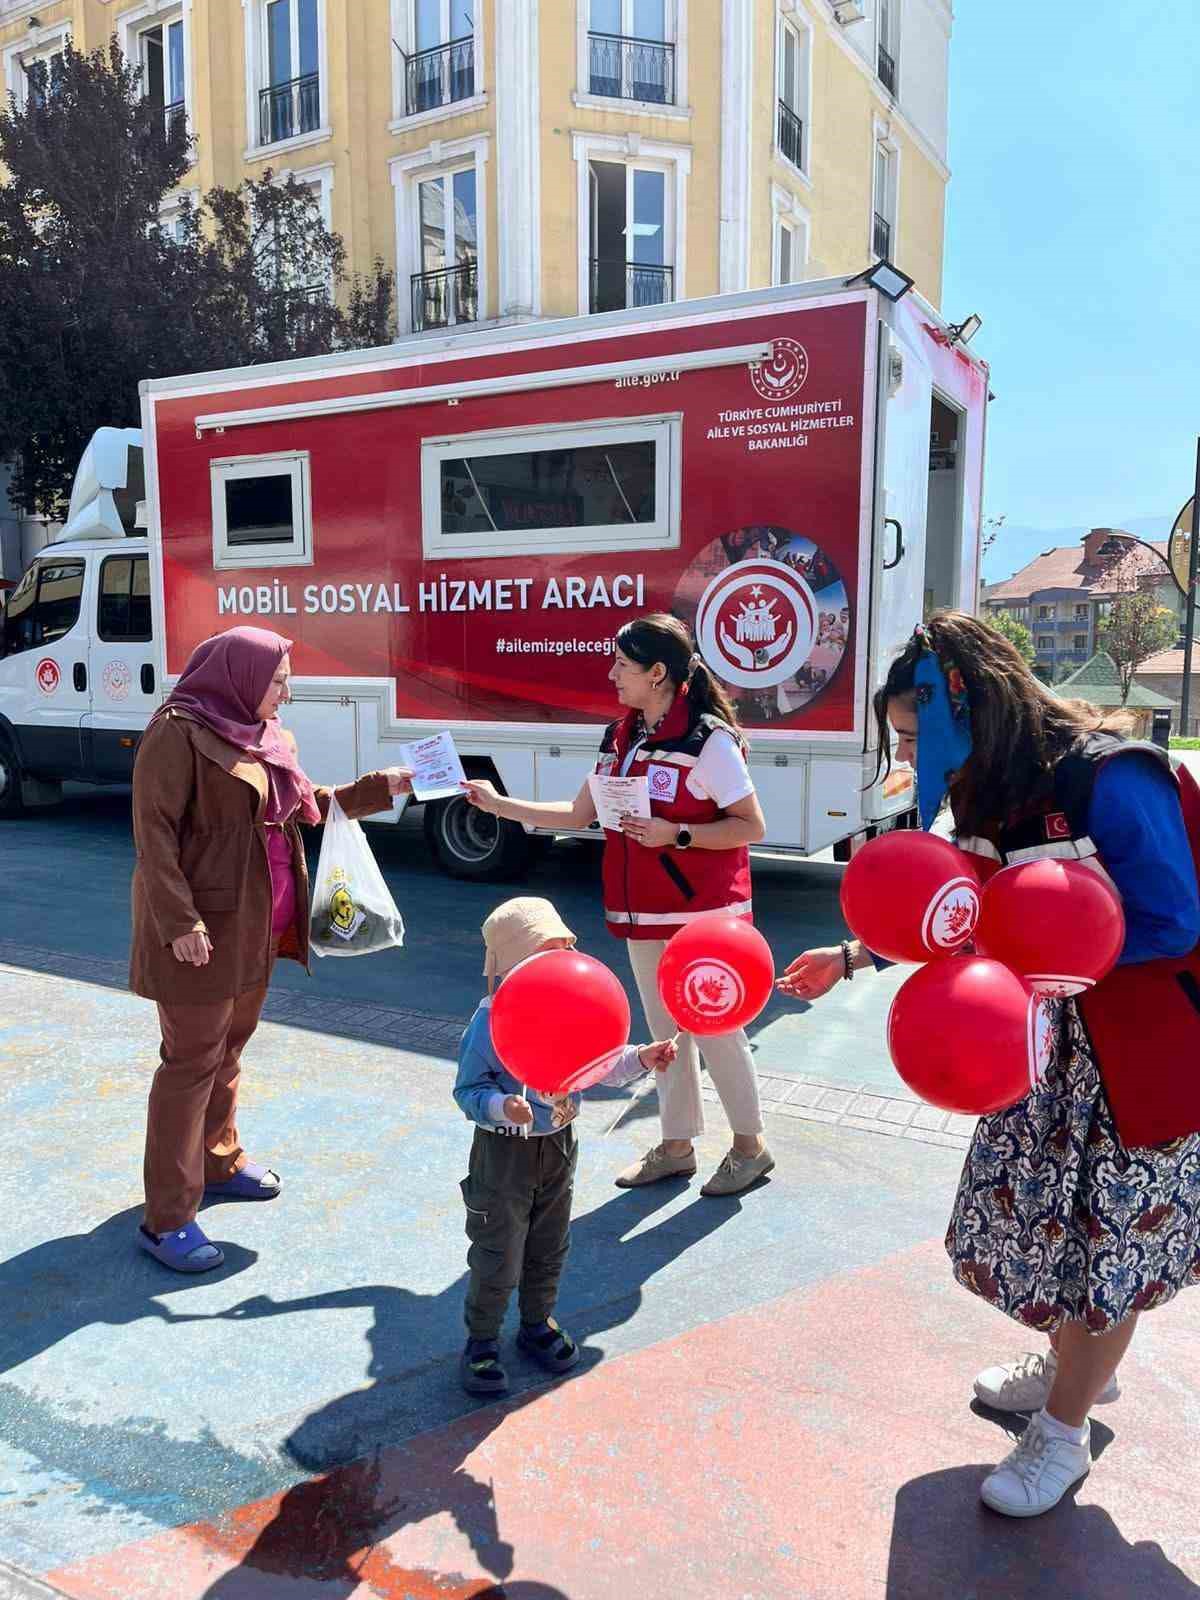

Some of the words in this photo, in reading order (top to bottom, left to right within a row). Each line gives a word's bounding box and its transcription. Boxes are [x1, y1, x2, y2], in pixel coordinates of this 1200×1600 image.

[718, 407, 763, 422] TÜRKİYE
[765, 399, 842, 418] CUMHURİYETİ
[707, 426, 730, 439] AİLE
[731, 427, 745, 437] VE
[747, 423, 788, 435] SOSYAL
[791, 415, 854, 431] HİZMETLER
[748, 434, 808, 450] BAKANLIĞI
[218, 578, 297, 614] MOBİL
[304, 583, 410, 613] SOSYAL
[418, 573, 533, 612] HİZMET
[541, 574, 645, 609] ARACI
[496, 638, 616, 656] #ailemizgeleceği
